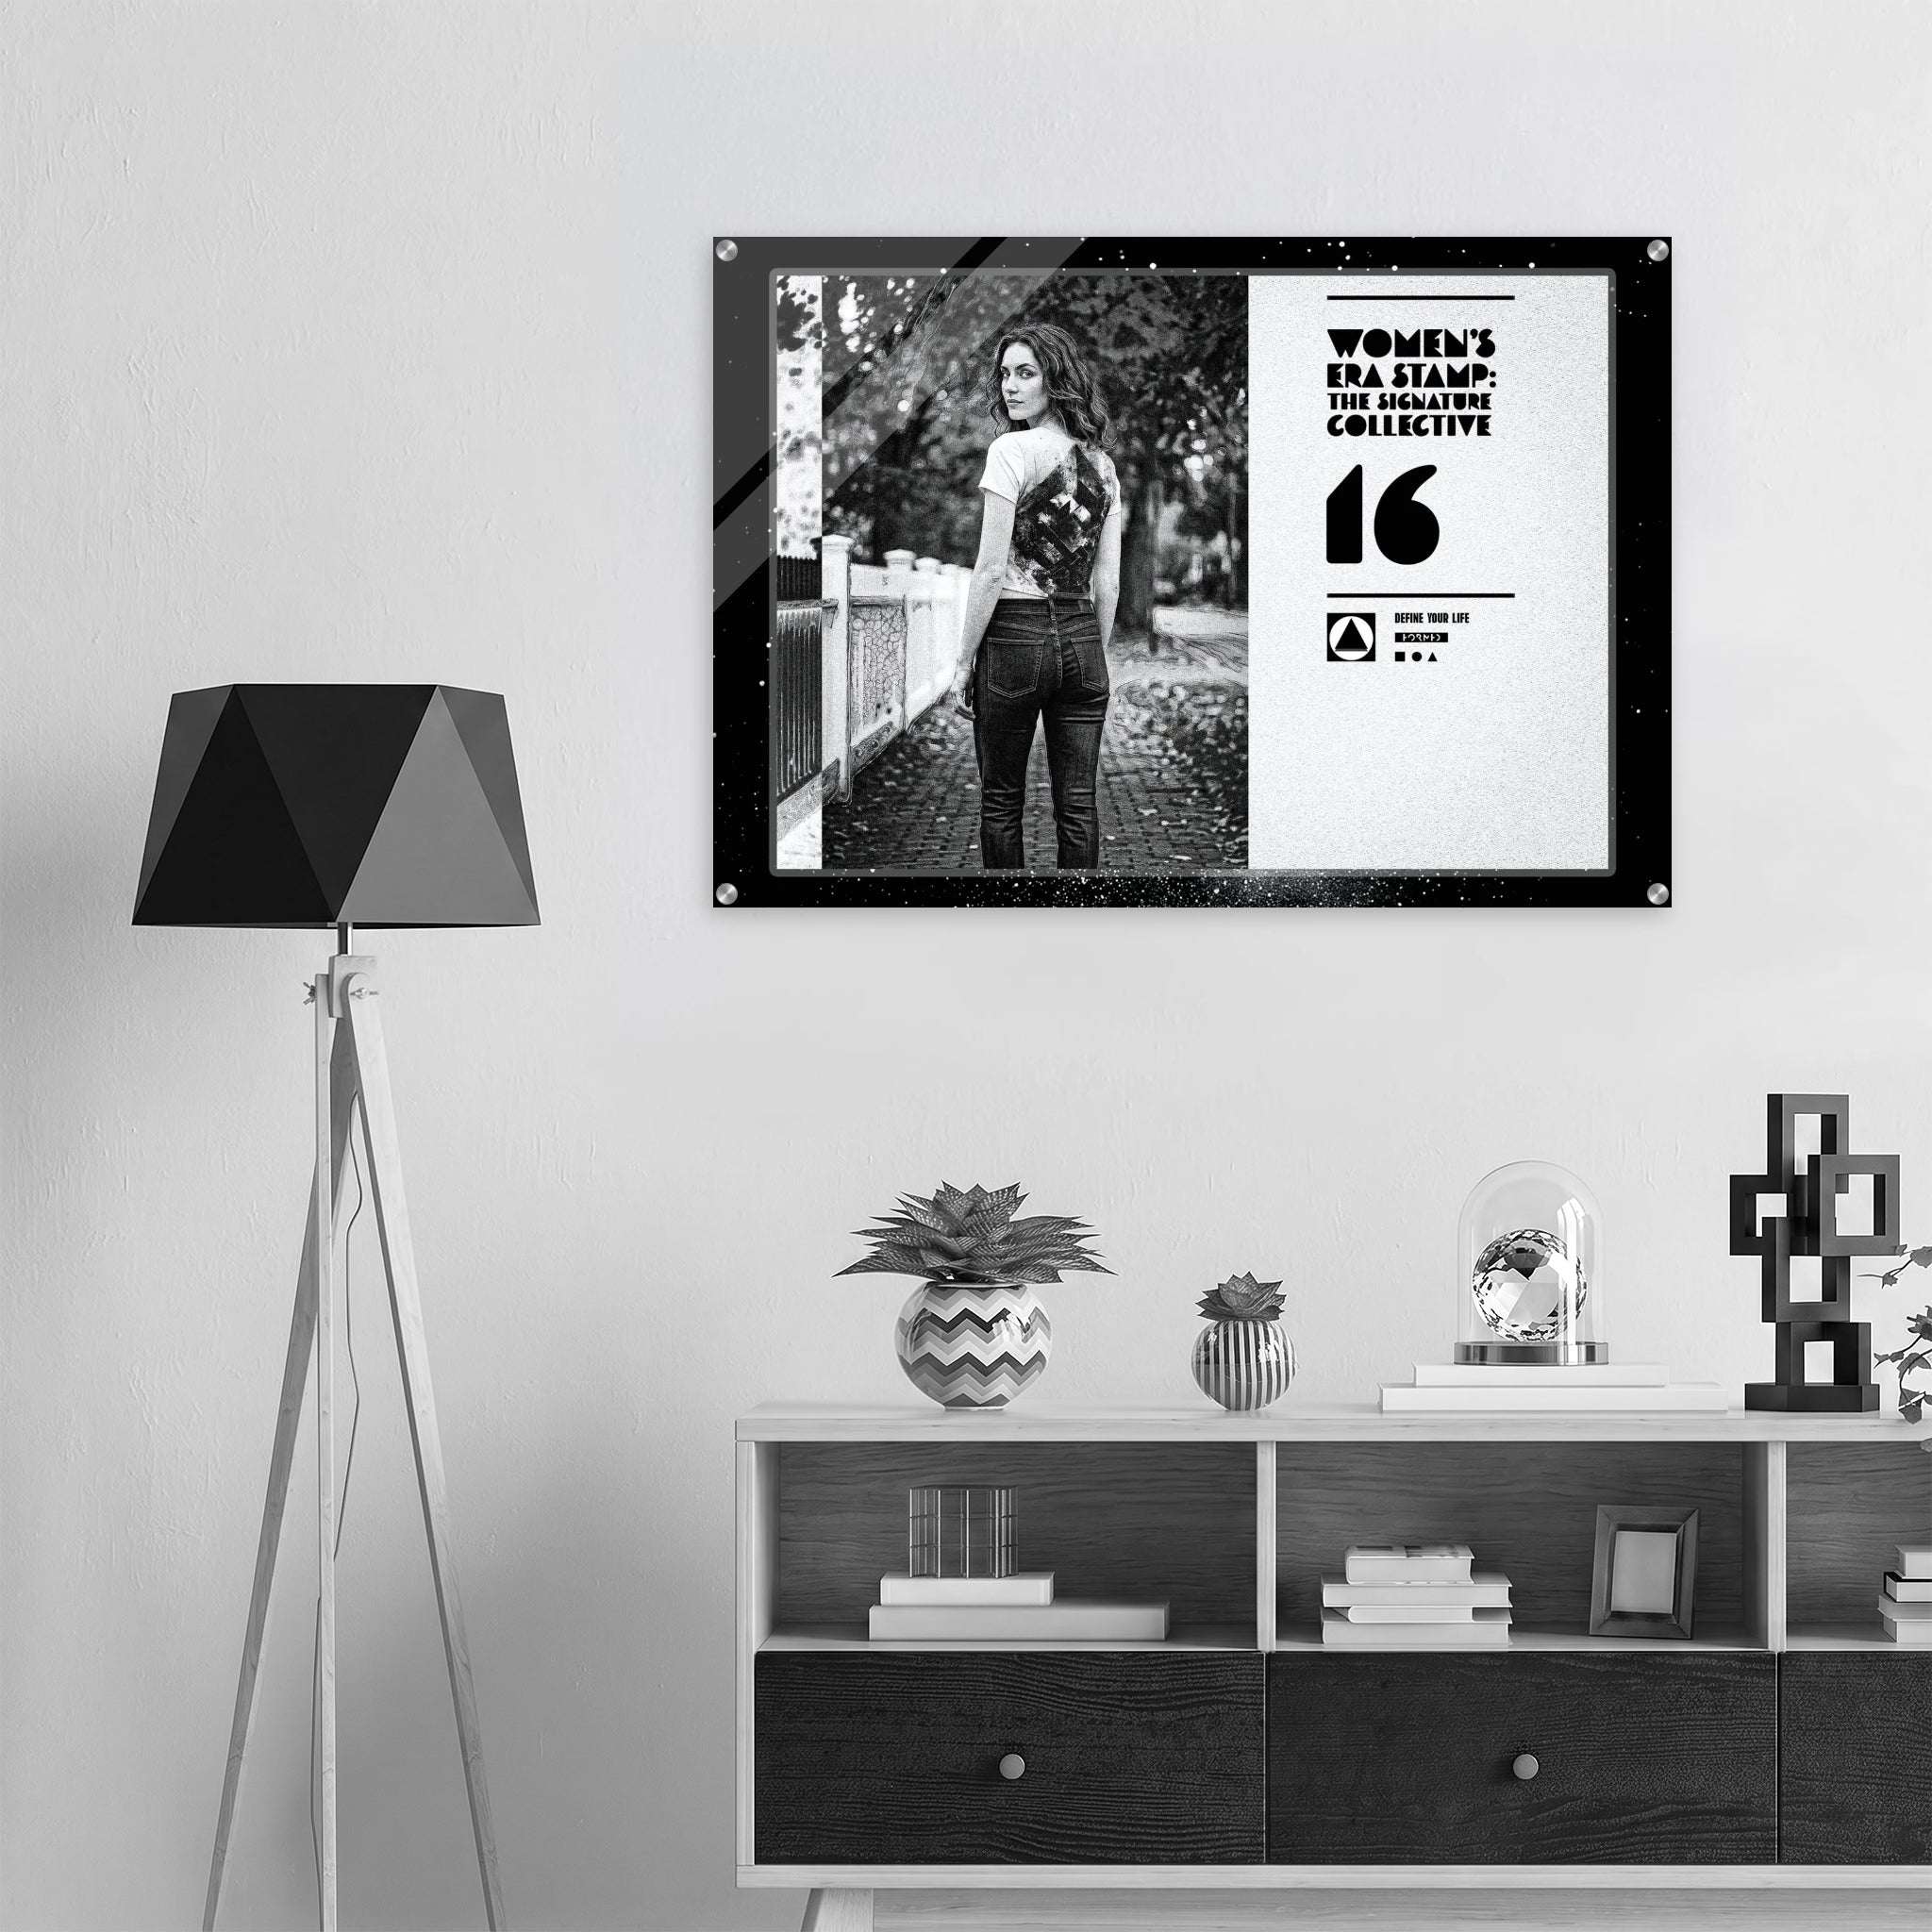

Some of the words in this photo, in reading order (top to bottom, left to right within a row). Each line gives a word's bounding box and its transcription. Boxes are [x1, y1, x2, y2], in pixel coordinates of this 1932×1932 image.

[1327, 329, 1496, 358] WOMEN'S
[1327, 363, 1384, 388] ERA
[1391, 363, 1497, 388] STAMP:
[1327, 392, 1370, 410] THE
[1377, 392, 1491, 410] SIGNATURE
[1327, 415, 1491, 437] COLLECTIVE
[1326, 464, 1440, 565] 16
[1394, 613, 1424, 624] DEFINE
[1427, 613, 1449, 624] YOUR
[1452, 613, 1470, 624] LIFE
